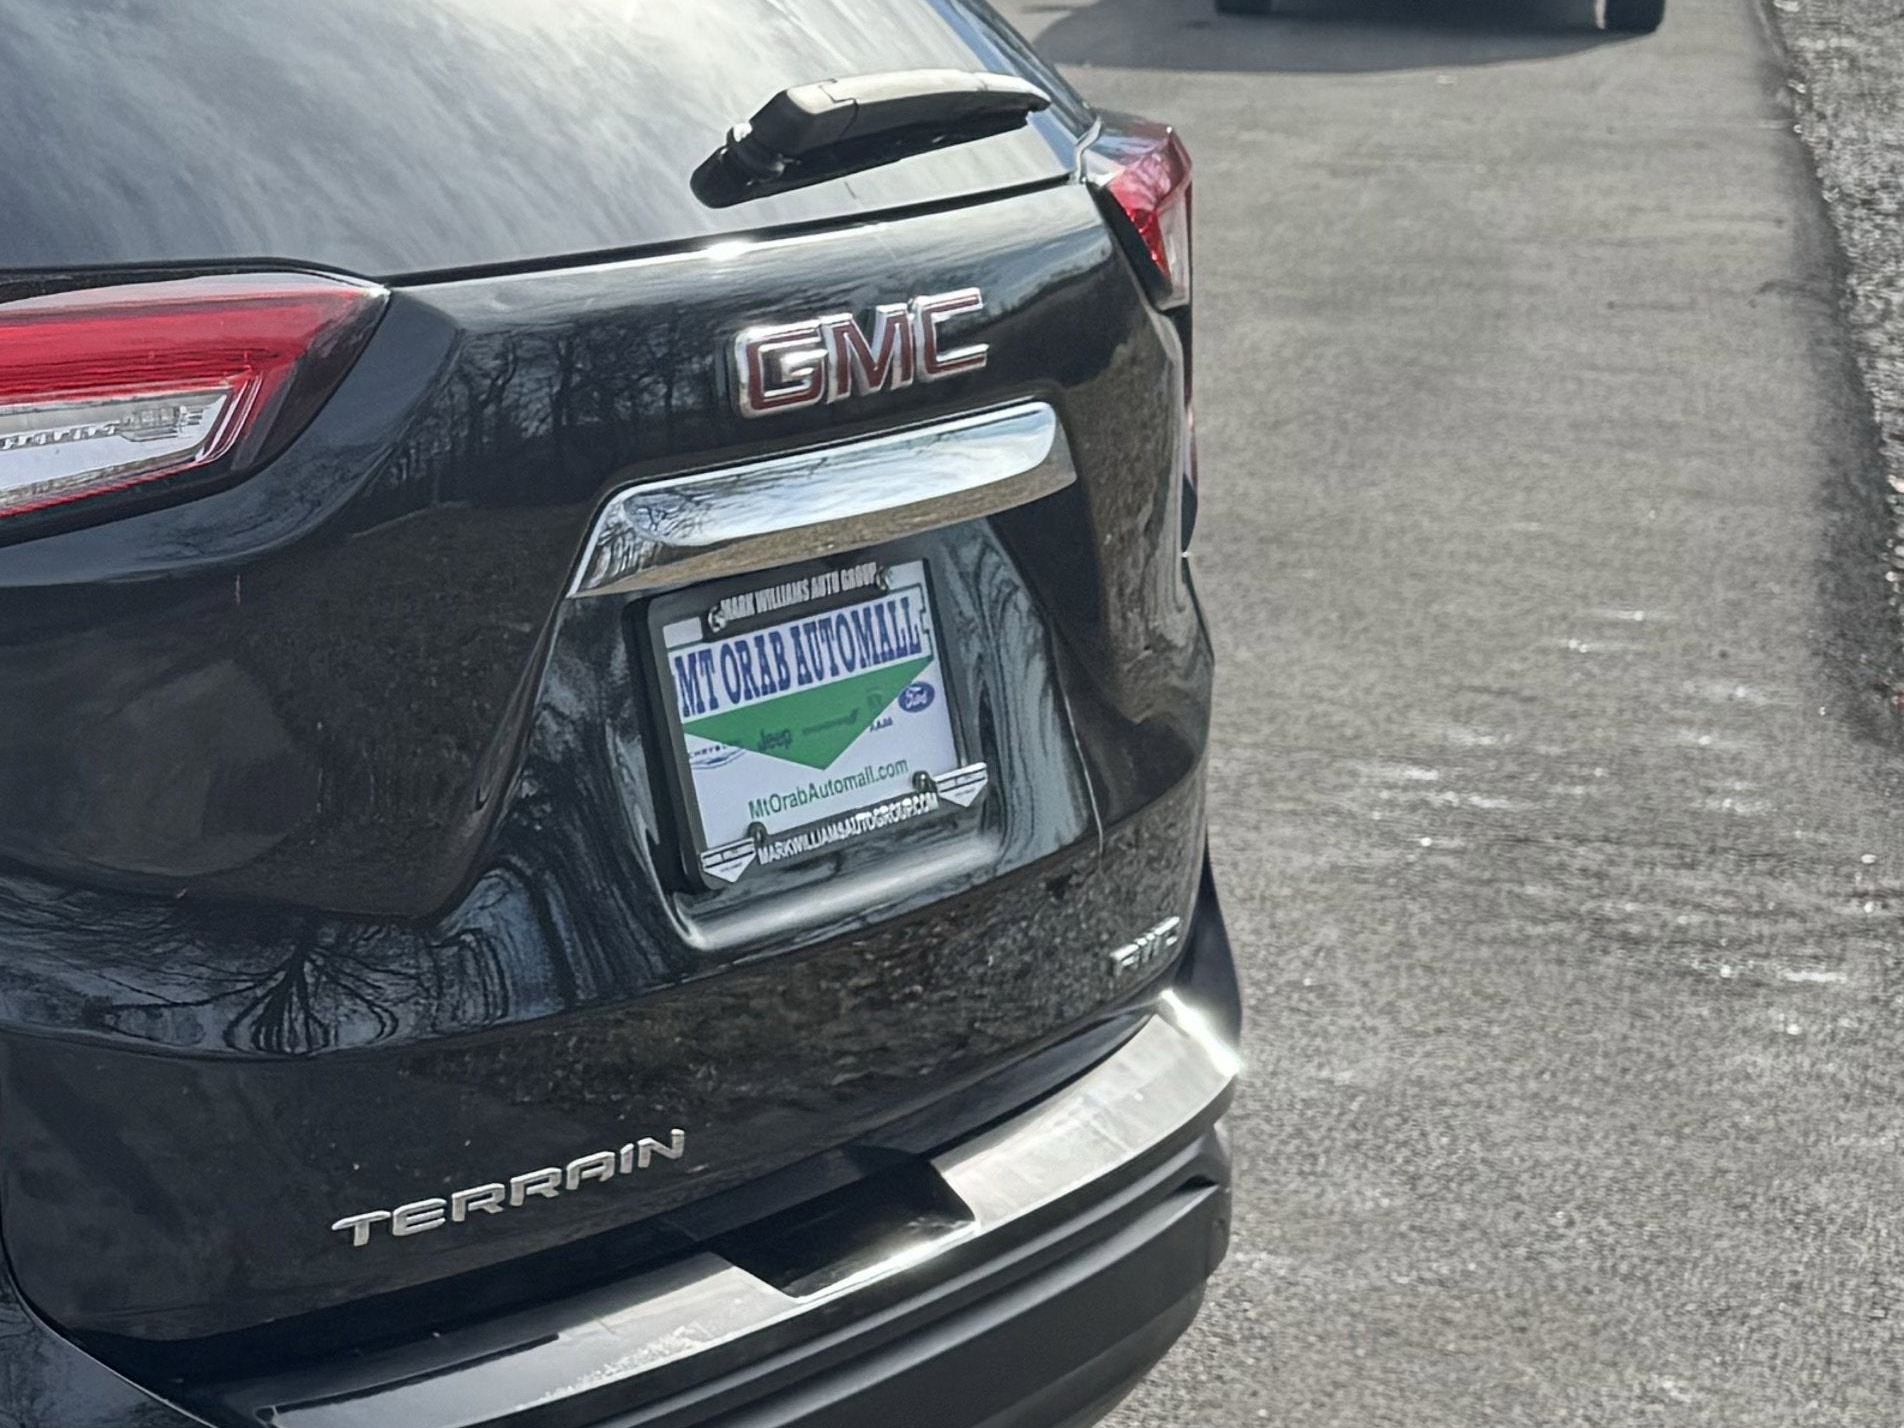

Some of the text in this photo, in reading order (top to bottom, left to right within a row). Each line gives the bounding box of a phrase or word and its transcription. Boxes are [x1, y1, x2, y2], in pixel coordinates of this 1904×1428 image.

[733, 286, 990, 419] GMC
[754, 579, 811, 613] WILLIAMS
[810, 572, 841, 599] AUTO
[841, 561, 877, 593] GROUP
[674, 596, 923, 718] MT ORAB AUTOMALL
[748, 759, 910, 820] MtOrabAutomall.com
[331, 1127, 686, 1247] TERRAIN
